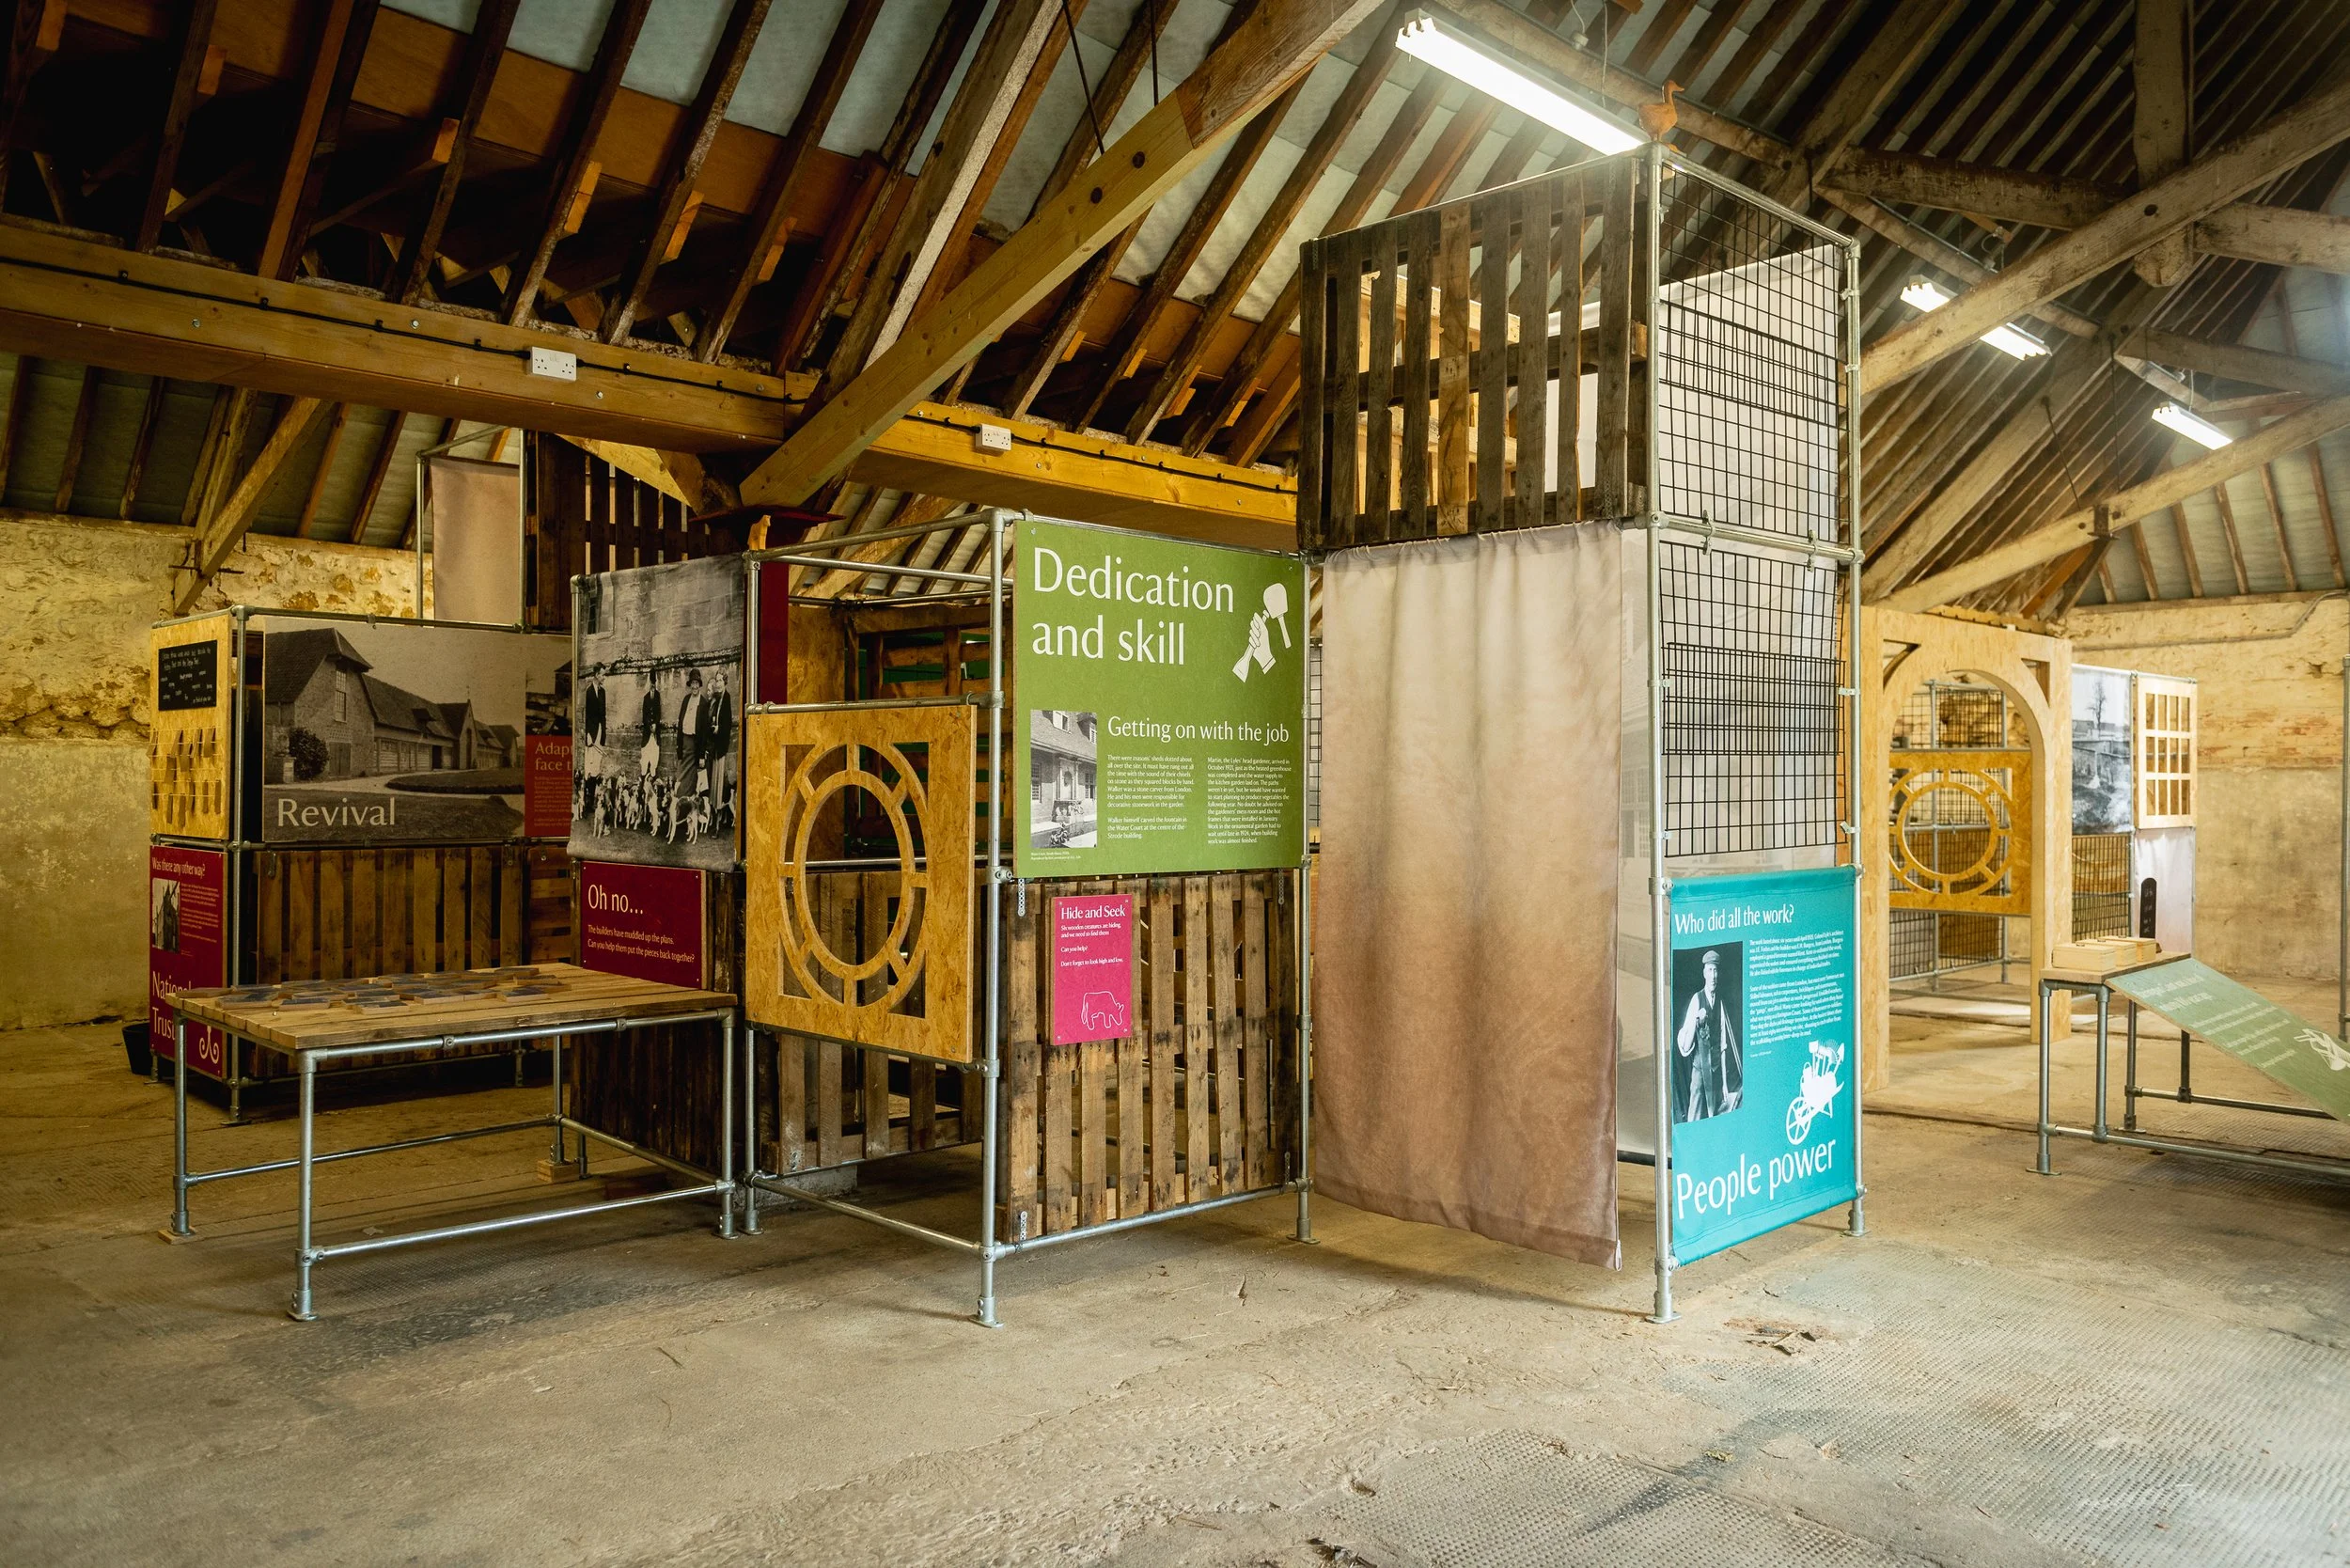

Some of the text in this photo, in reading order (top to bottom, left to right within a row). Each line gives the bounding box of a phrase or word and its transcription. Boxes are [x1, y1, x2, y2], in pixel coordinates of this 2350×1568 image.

[1035, 547, 1233, 612] Dedication
[1032, 615, 1184, 665] and skill
[1108, 716, 1289, 746] Getting on with the job
[535, 758, 563, 770] face
[278, 797, 395, 826] Revival
[152, 857, 161, 870] Was
[162, 858, 172, 872] there
[182, 861, 193, 875] other
[194, 863, 205, 879] way?
[588, 884, 643, 914] Oh no...
[1061, 905, 1126, 919] Hide and Seek
[1675, 904, 1794, 934] Who did all the work?
[596, 926, 613, 936] builders
[614, 928, 624, 938] have
[624, 930, 644, 941] muddled
[645, 935, 651, 943] up
[660, 935, 674, 945] plans.
[587, 939, 596, 948] Can
[605, 942, 615, 952] help
[616, 943, 627, 952] them
[645, 948, 659, 957] pieces
[660, 949, 670, 959] back
[671, 953, 695, 963] together?
[1677, 1139, 1836, 1219] People power
